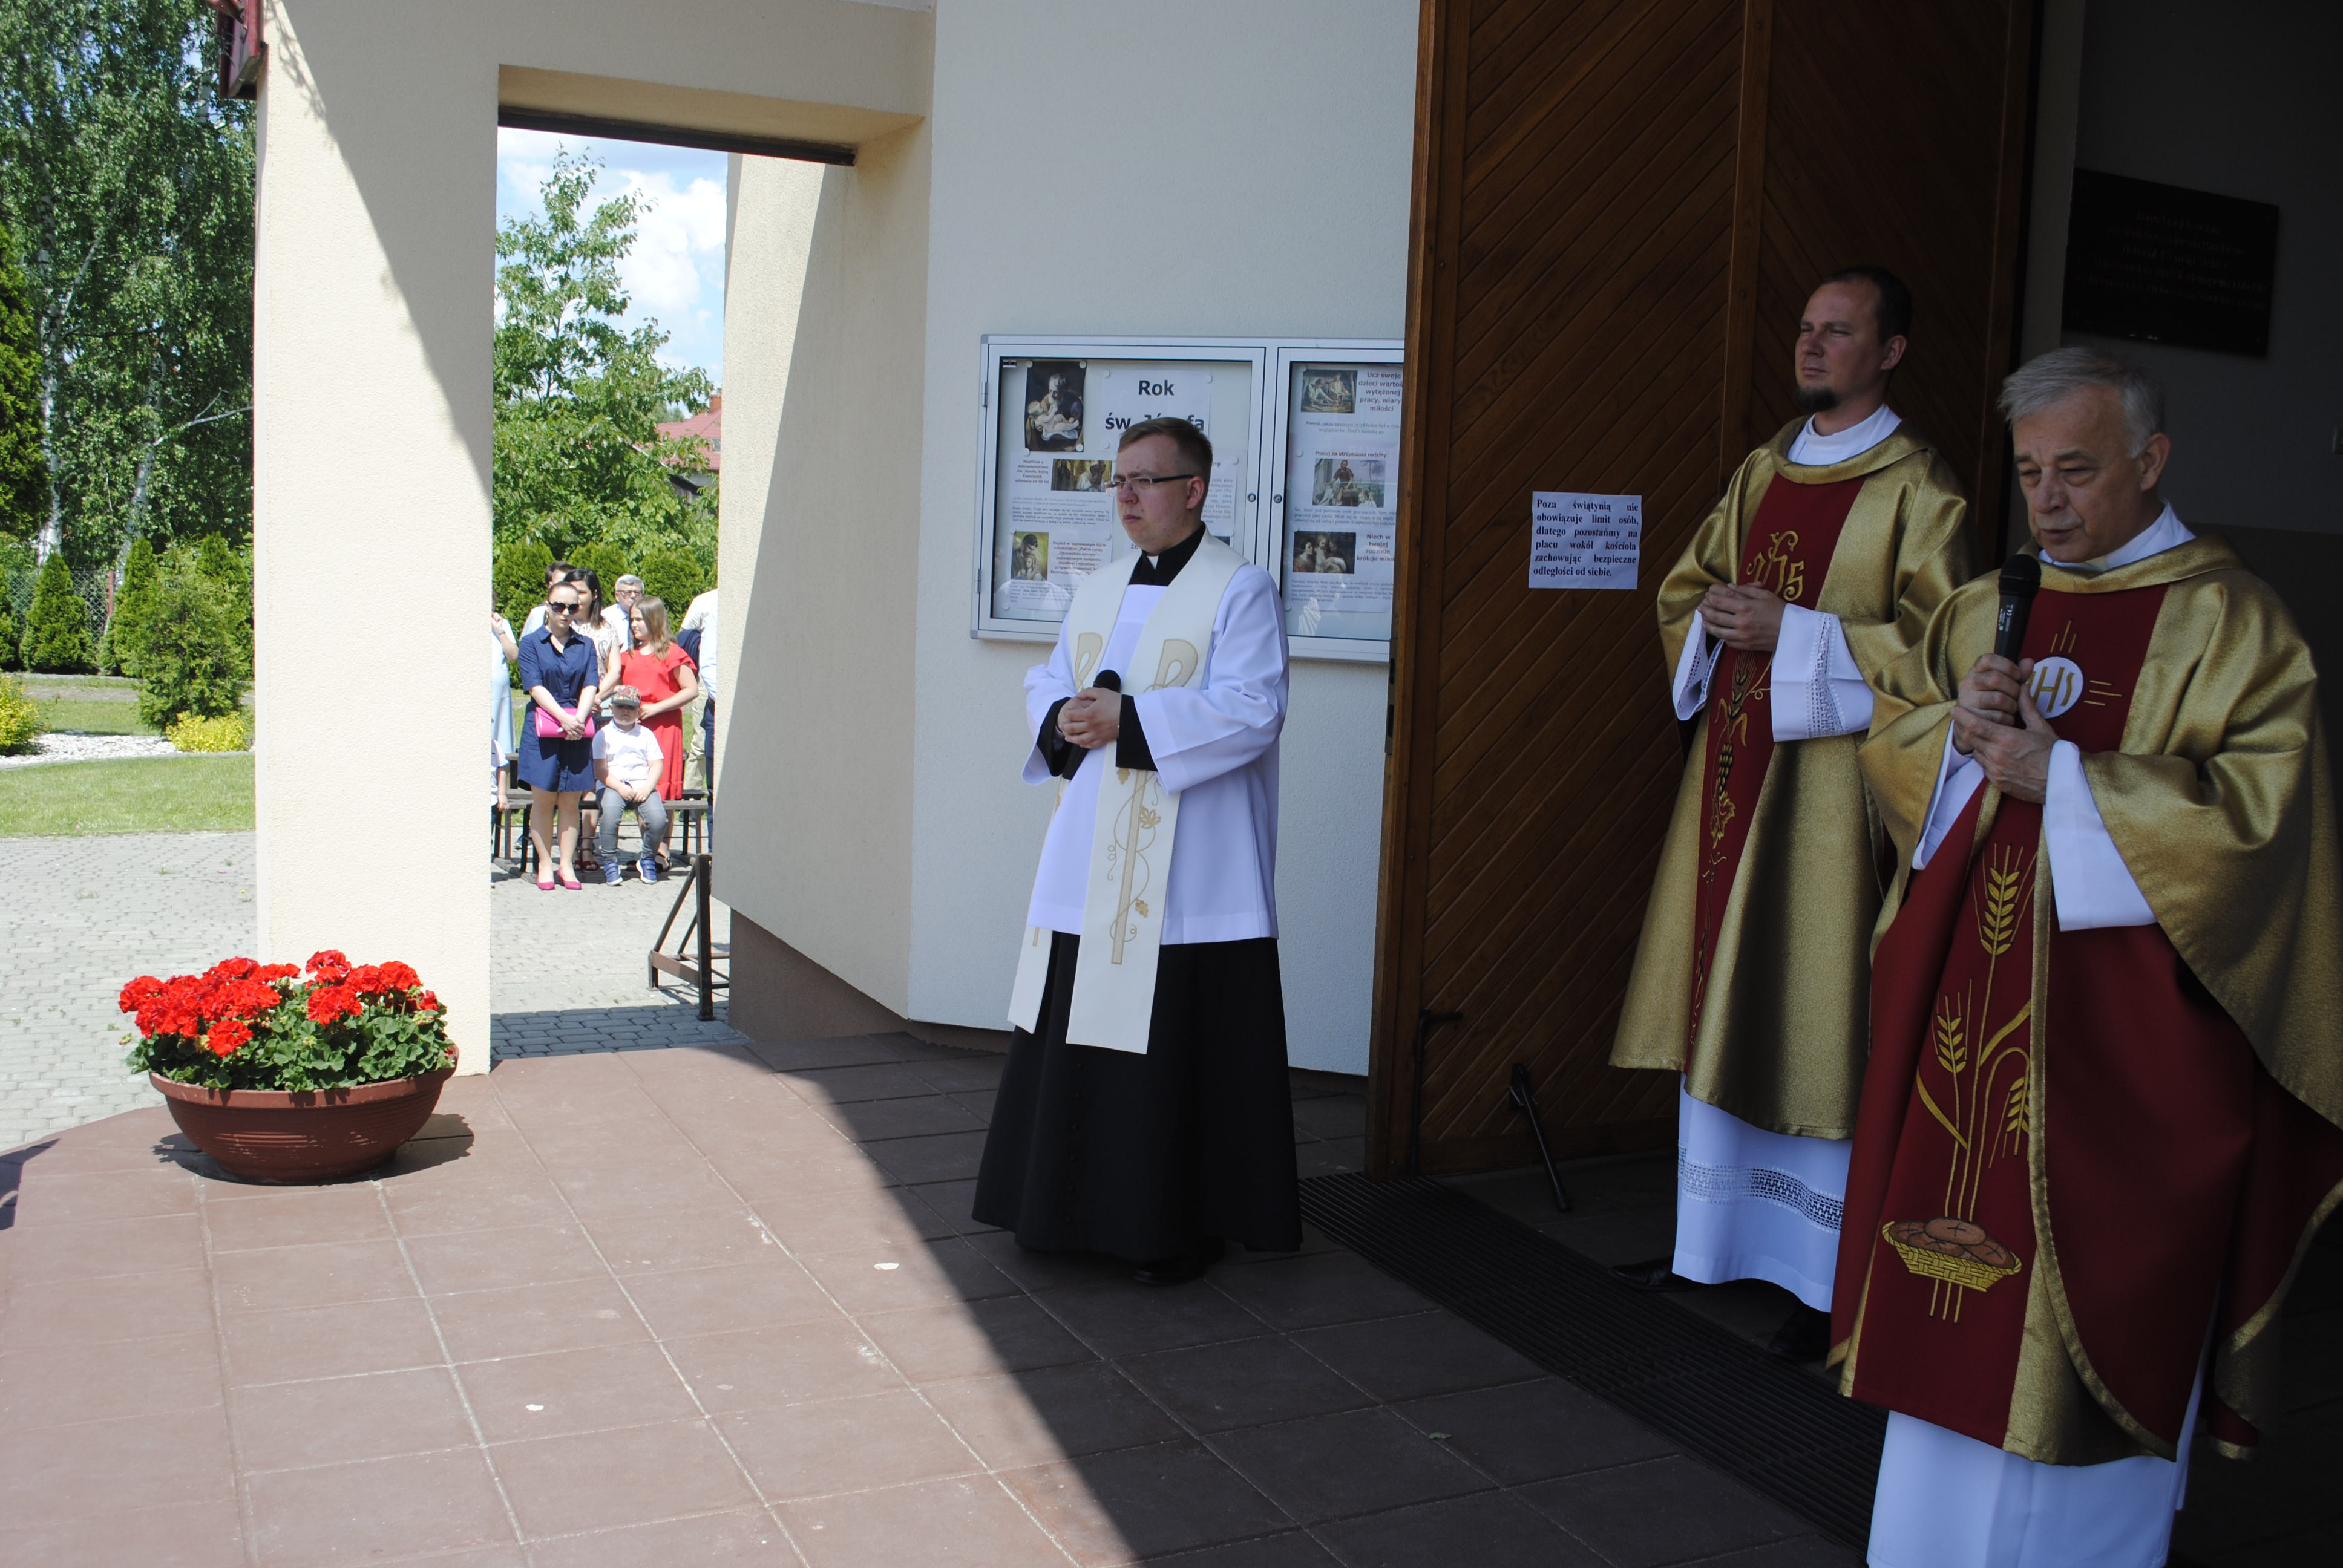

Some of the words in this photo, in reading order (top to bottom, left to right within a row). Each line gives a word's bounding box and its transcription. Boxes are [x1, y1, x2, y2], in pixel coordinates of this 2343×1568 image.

[1138, 380, 1175, 396] Rok
[1537, 499, 1556, 508] Poza
[1573, 500, 1611, 512] świątynią
[1627, 503, 1638, 511] nie
[1536, 513, 1583, 524] obowiązuje
[1592, 514, 1610, 523] limit
[1619, 515, 1639, 526] osób,
[1536, 526, 1566, 537] dlatego
[1574, 528, 1621, 539] pozostańmy
[1536, 540, 1558, 550] placu
[1570, 540, 1593, 549] wokół
[1605, 541, 1636, 550] kościoła
[1535, 553, 1582, 564] zachowując
[1593, 554, 1636, 565] bezpieczne
[1533, 566, 1573, 577] odległości
[1575, 567, 1585, 576] od
[1588, 567, 1612, 577] siebie.
